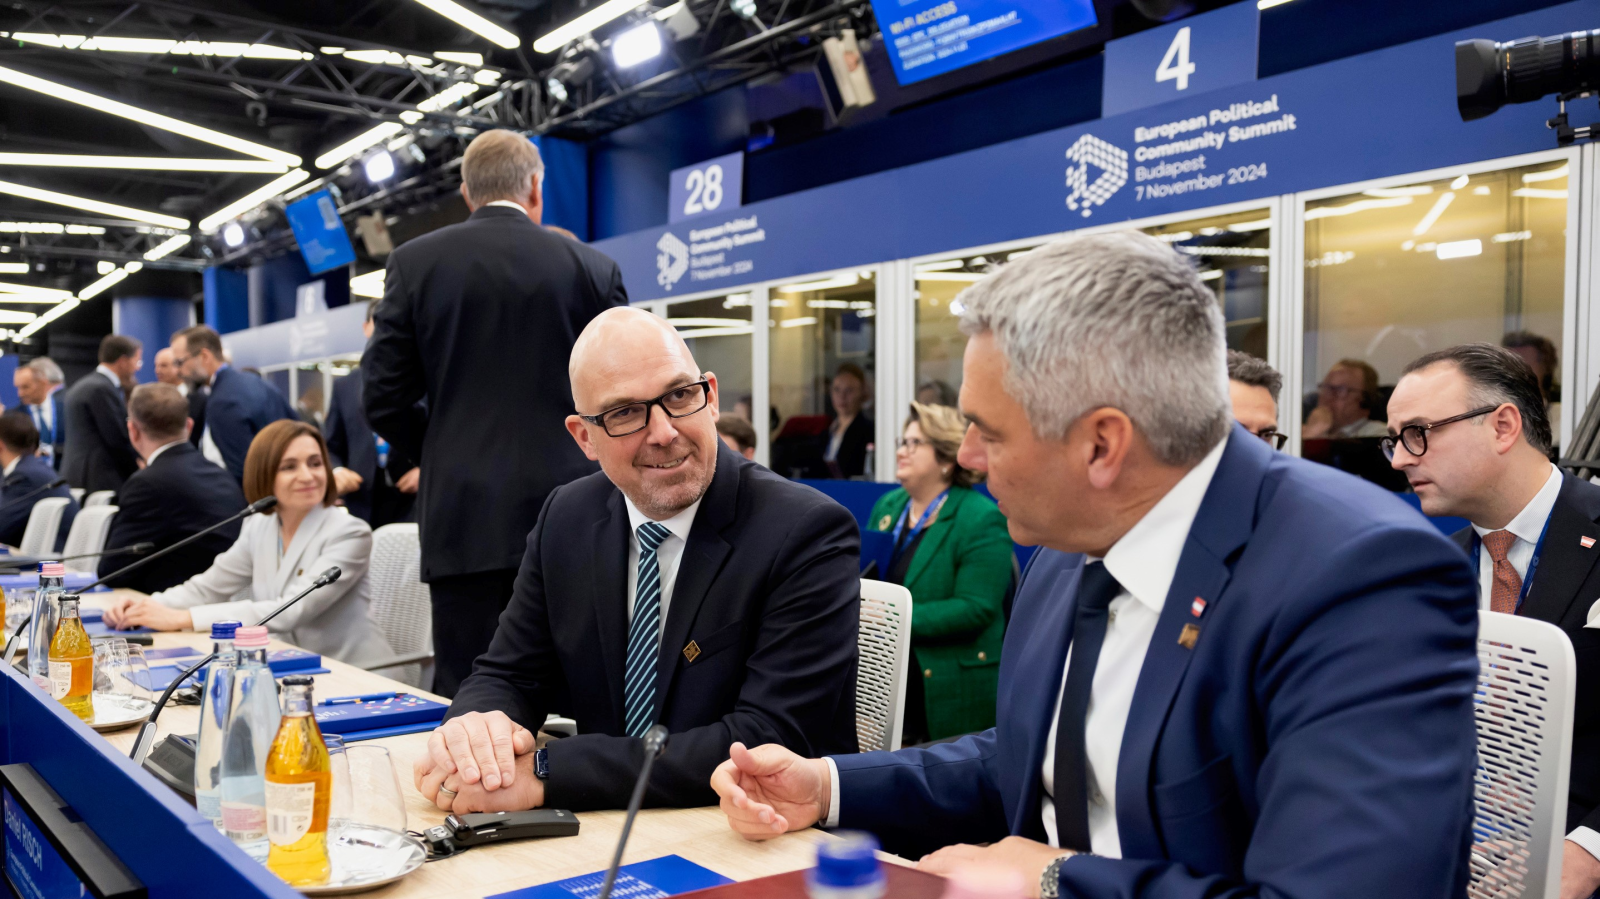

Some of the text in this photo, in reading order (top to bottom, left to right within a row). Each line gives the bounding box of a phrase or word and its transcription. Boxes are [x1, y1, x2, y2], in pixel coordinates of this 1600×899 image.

[1155, 26, 1196, 91] 4
[1134, 94, 1280, 143] European Political
[1134, 114, 1297, 162] Community Summit
[683, 164, 723, 215] 28
[1135, 154, 1206, 182] Budapest
[1135, 162, 1268, 201] 7 November 2024
[22, 822, 43, 872] RISCH
